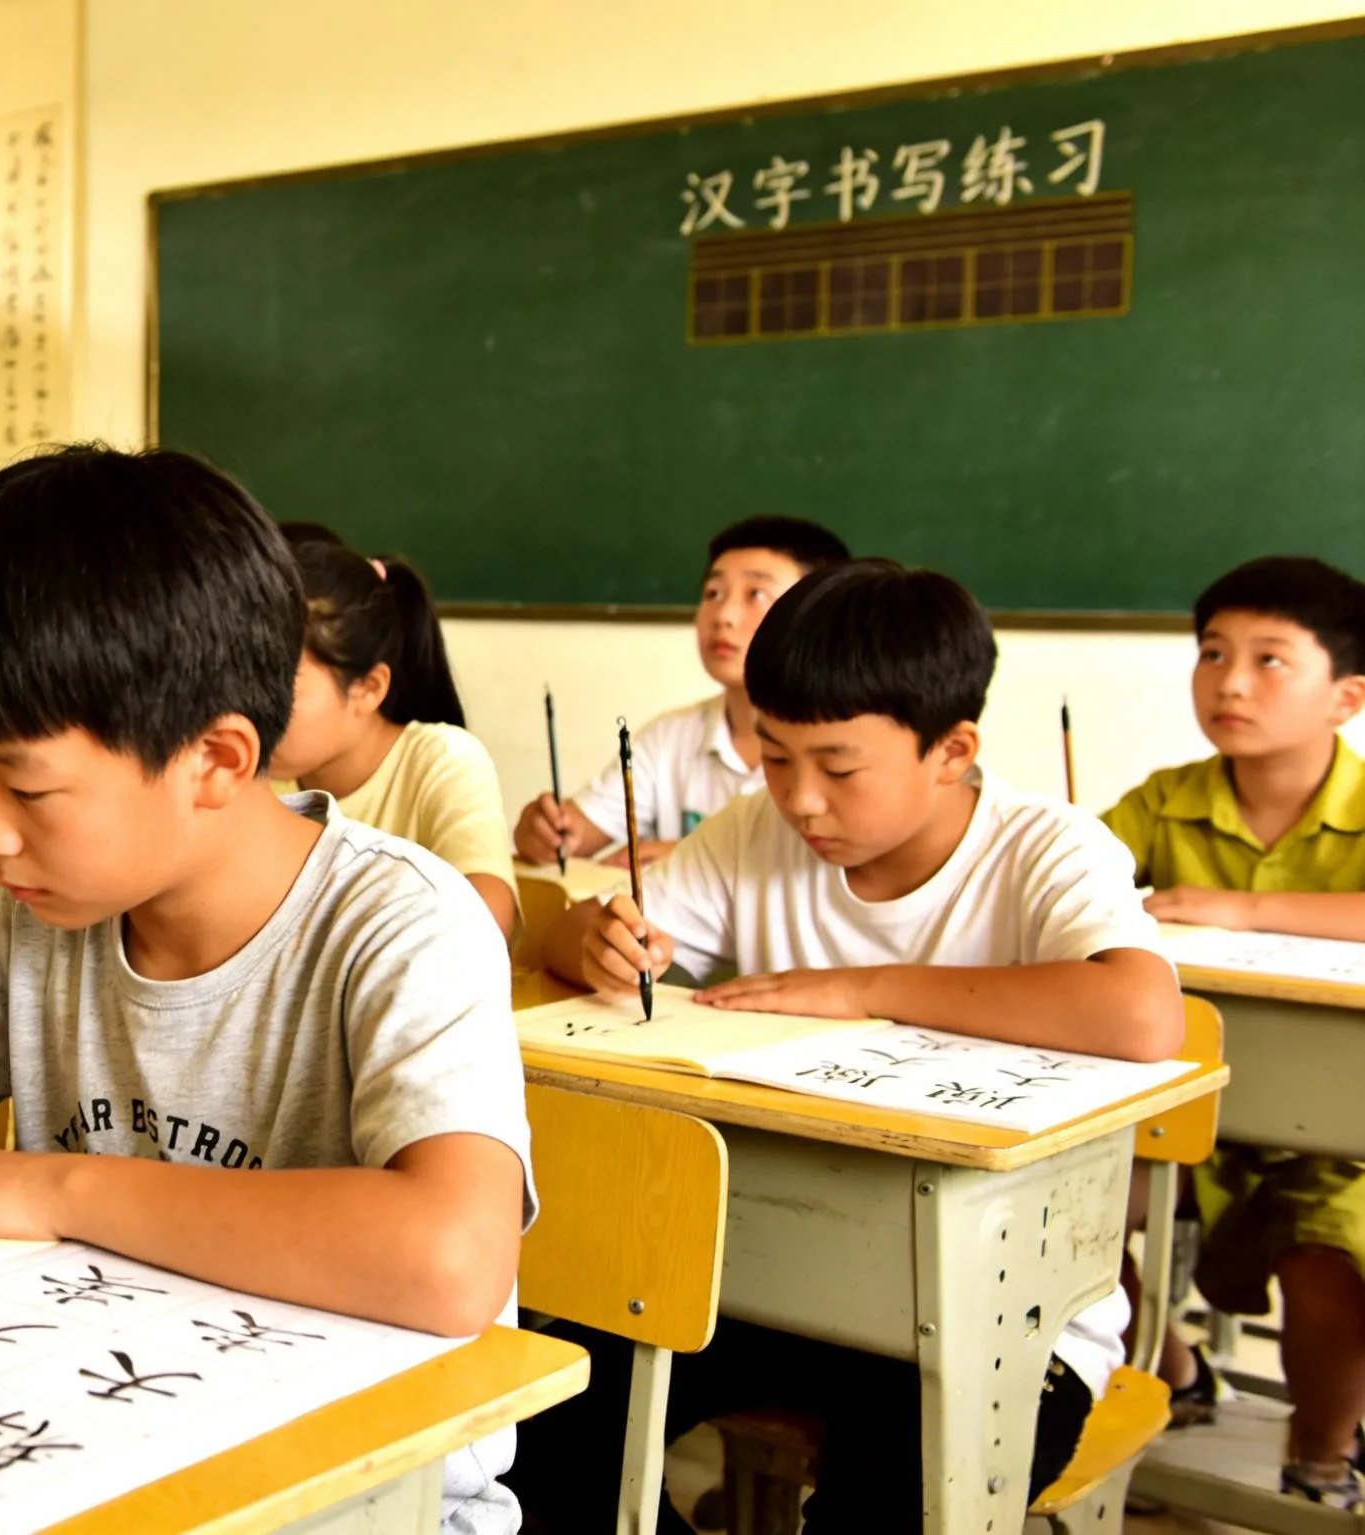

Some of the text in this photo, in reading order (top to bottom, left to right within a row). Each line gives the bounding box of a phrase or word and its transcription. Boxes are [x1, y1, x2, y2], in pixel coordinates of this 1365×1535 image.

[679, 119, 1106, 236] 汉字书写练习
